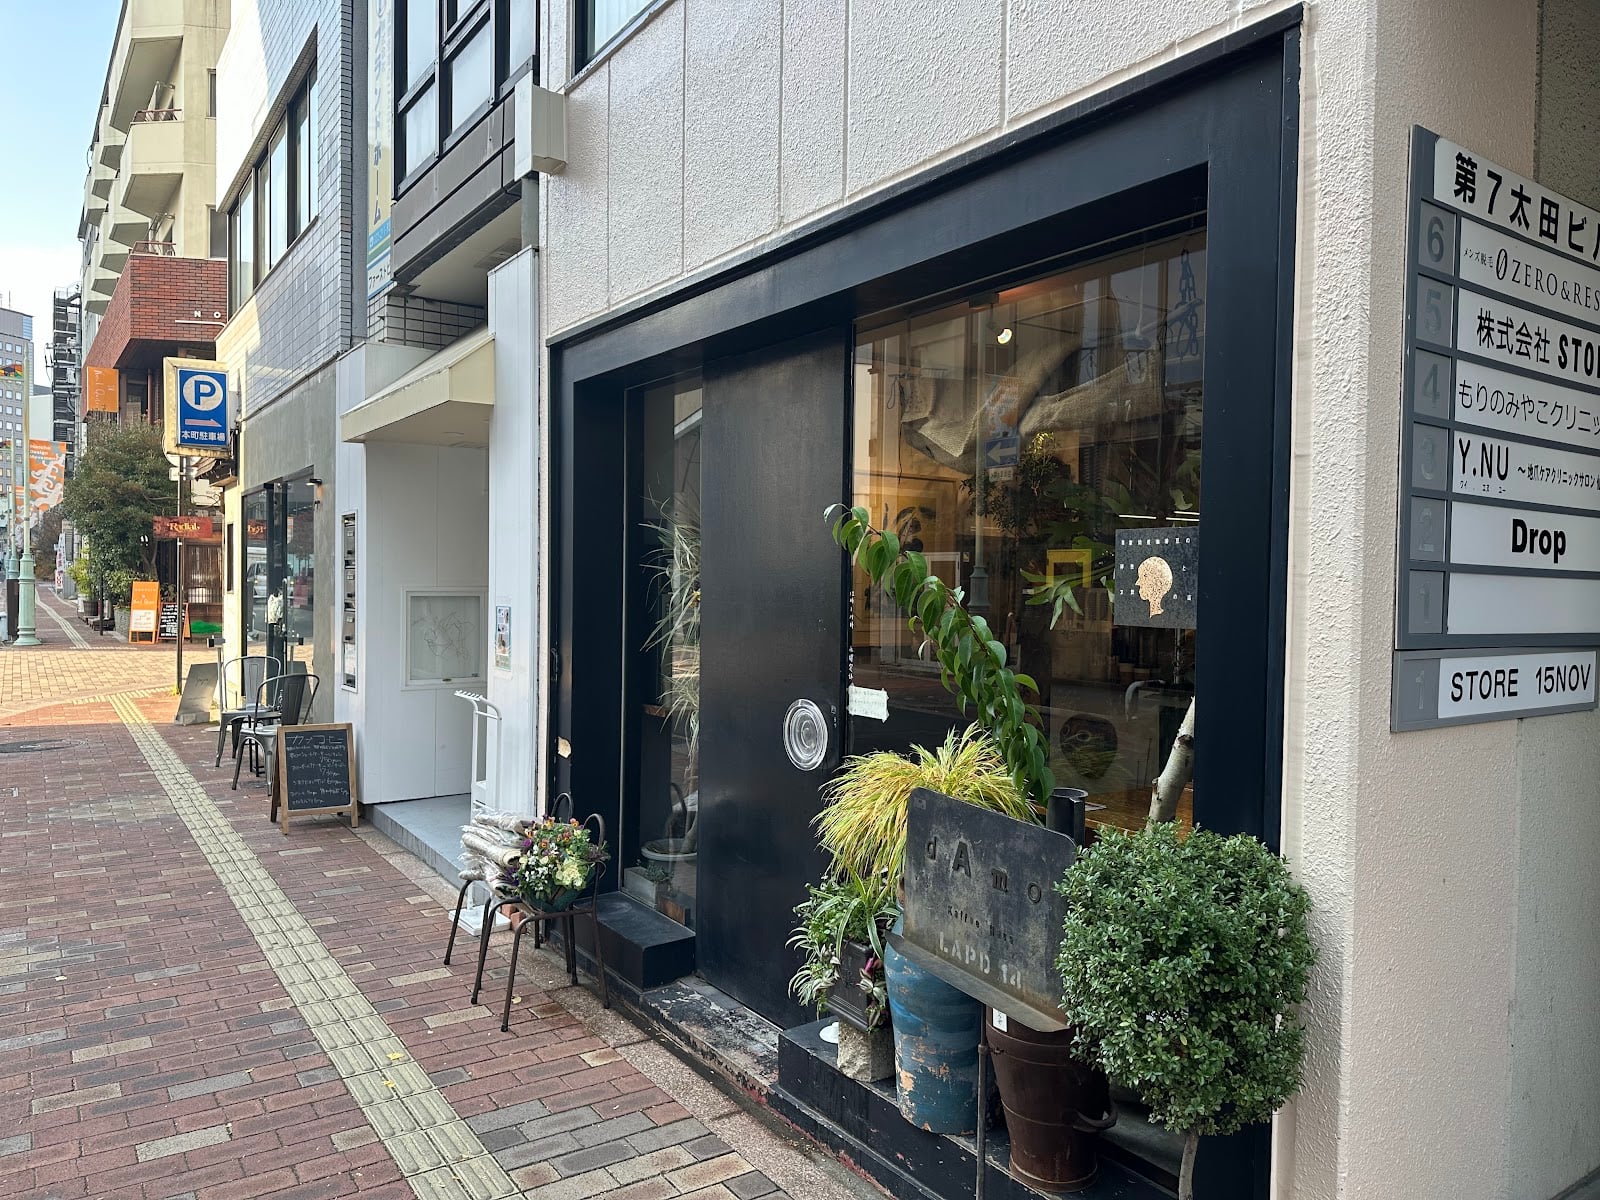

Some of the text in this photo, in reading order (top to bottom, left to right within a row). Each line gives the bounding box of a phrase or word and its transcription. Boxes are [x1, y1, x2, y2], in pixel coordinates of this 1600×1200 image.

[1427, 216, 1444, 263] 6
[1425, 288, 1442, 336] 5
[1476, 307, 1550, 364] 株式会社
[194, 380, 216, 405] P
[1422, 362, 1440, 407] 4
[181, 429, 226, 442] 本町駐車場
[1458, 437, 1509, 481] Y.NU
[1511, 518, 1567, 564] Drop
[1451, 668, 1519, 702] STORE
[1535, 663, 1592, 695] 15NOV
